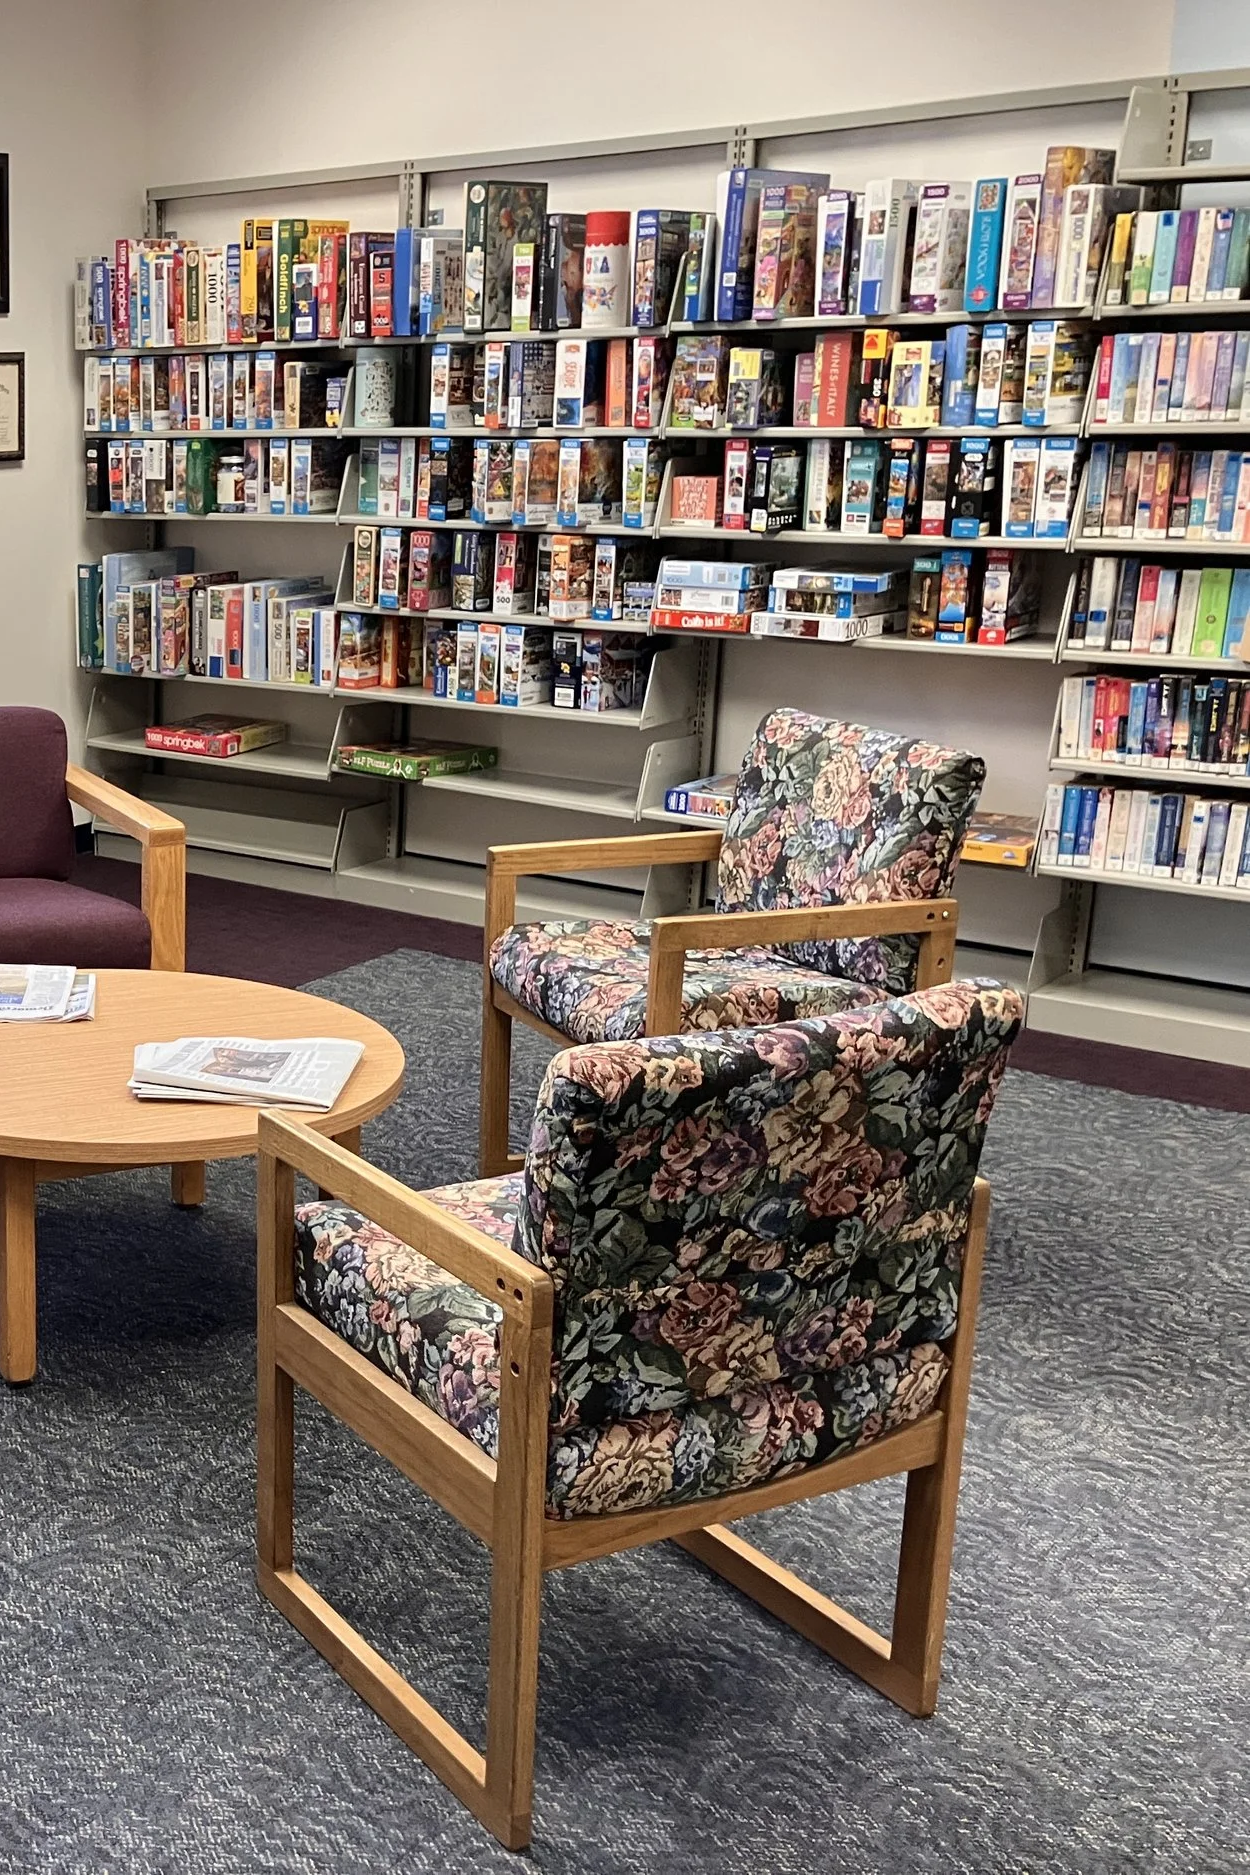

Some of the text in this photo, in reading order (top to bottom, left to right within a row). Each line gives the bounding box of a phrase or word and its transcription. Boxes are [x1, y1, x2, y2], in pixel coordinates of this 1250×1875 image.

[889, 198, 901, 228] 1500
[585, 256, 610, 274] USA
[116, 266, 129, 324] springbok
[207, 273, 218, 304] 1000
[278, 253, 290, 314] Goldfinch
[829, 342, 842, 381] WINES
[872, 378, 881, 396] 350
[826, 387, 839, 417] ITALY
[496, 596, 511, 604] 500
[274, 623, 282, 640] 500
[845, 619, 869, 639] 1000
[147, 732, 206, 751] 1000 springbok
